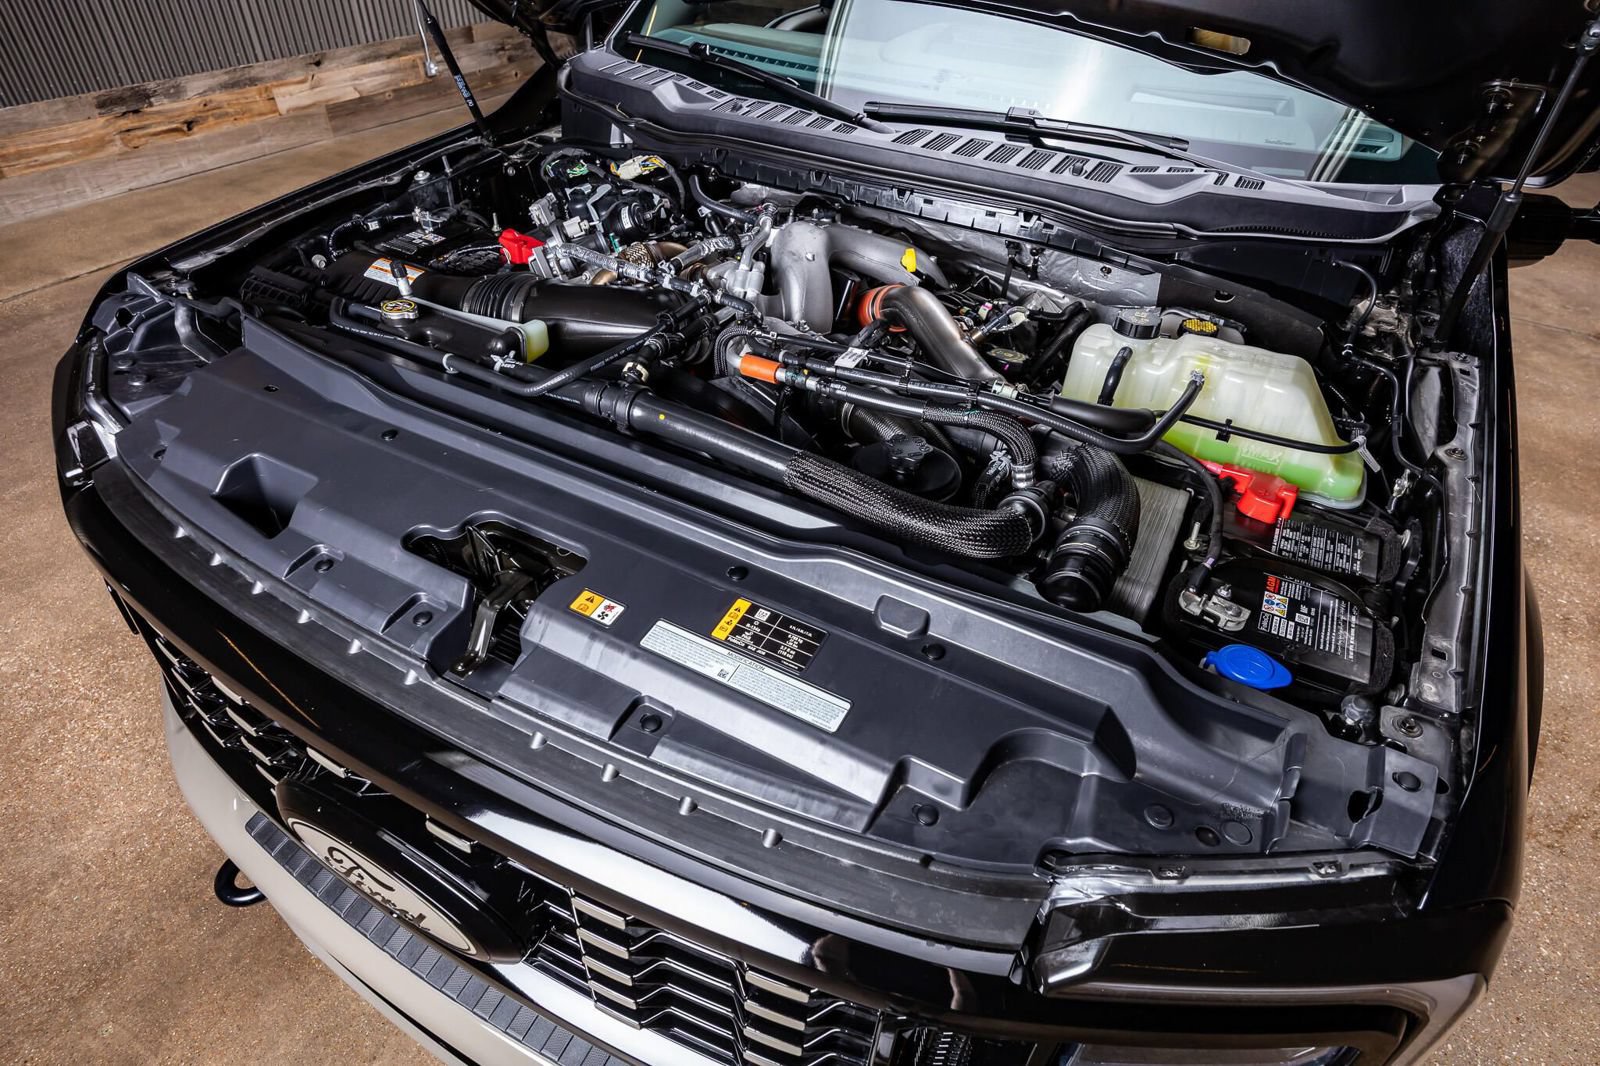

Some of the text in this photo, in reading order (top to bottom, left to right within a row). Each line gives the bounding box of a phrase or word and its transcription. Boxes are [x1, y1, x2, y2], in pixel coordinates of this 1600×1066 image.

[1266, 575, 1277, 592] AGM
[727, 651, 767, 672] MODIFICATION
[324, 846, 430, 932] Ford
